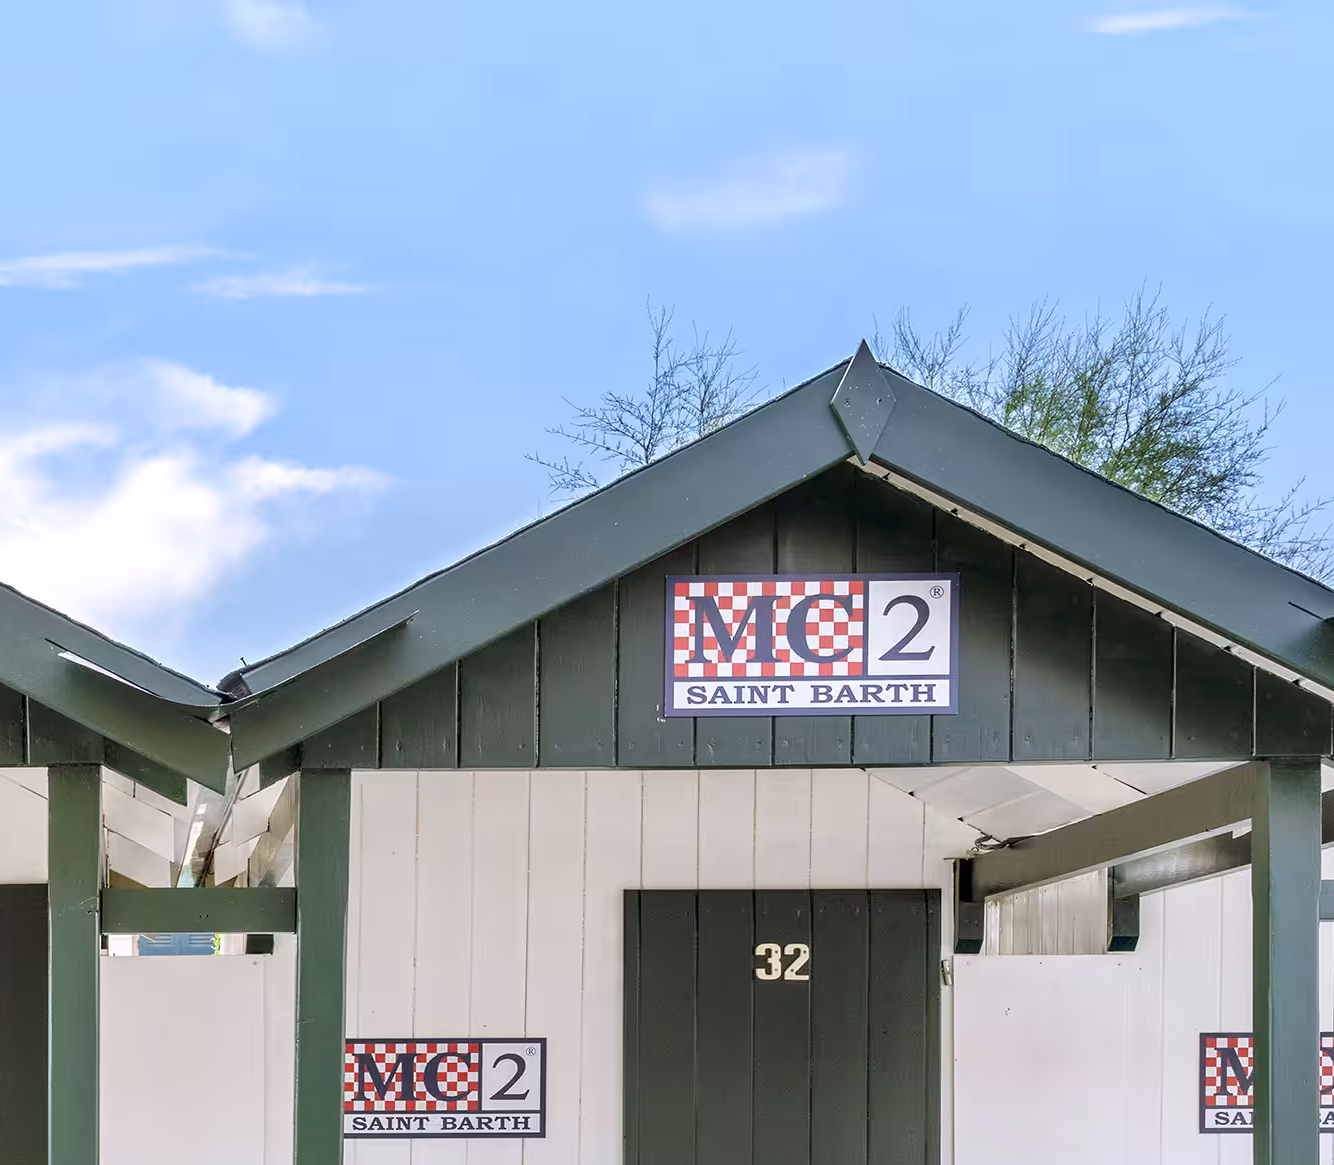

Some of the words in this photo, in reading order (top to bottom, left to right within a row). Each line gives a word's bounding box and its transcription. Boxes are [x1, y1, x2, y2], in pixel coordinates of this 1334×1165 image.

[686, 685, 795, 705] SAINT
[810, 684, 937, 704] BARTH
[755, 942, 810, 981] 32
[352, 1116, 430, 1131] SAINT
[440, 1116, 531, 1130] BARTH
